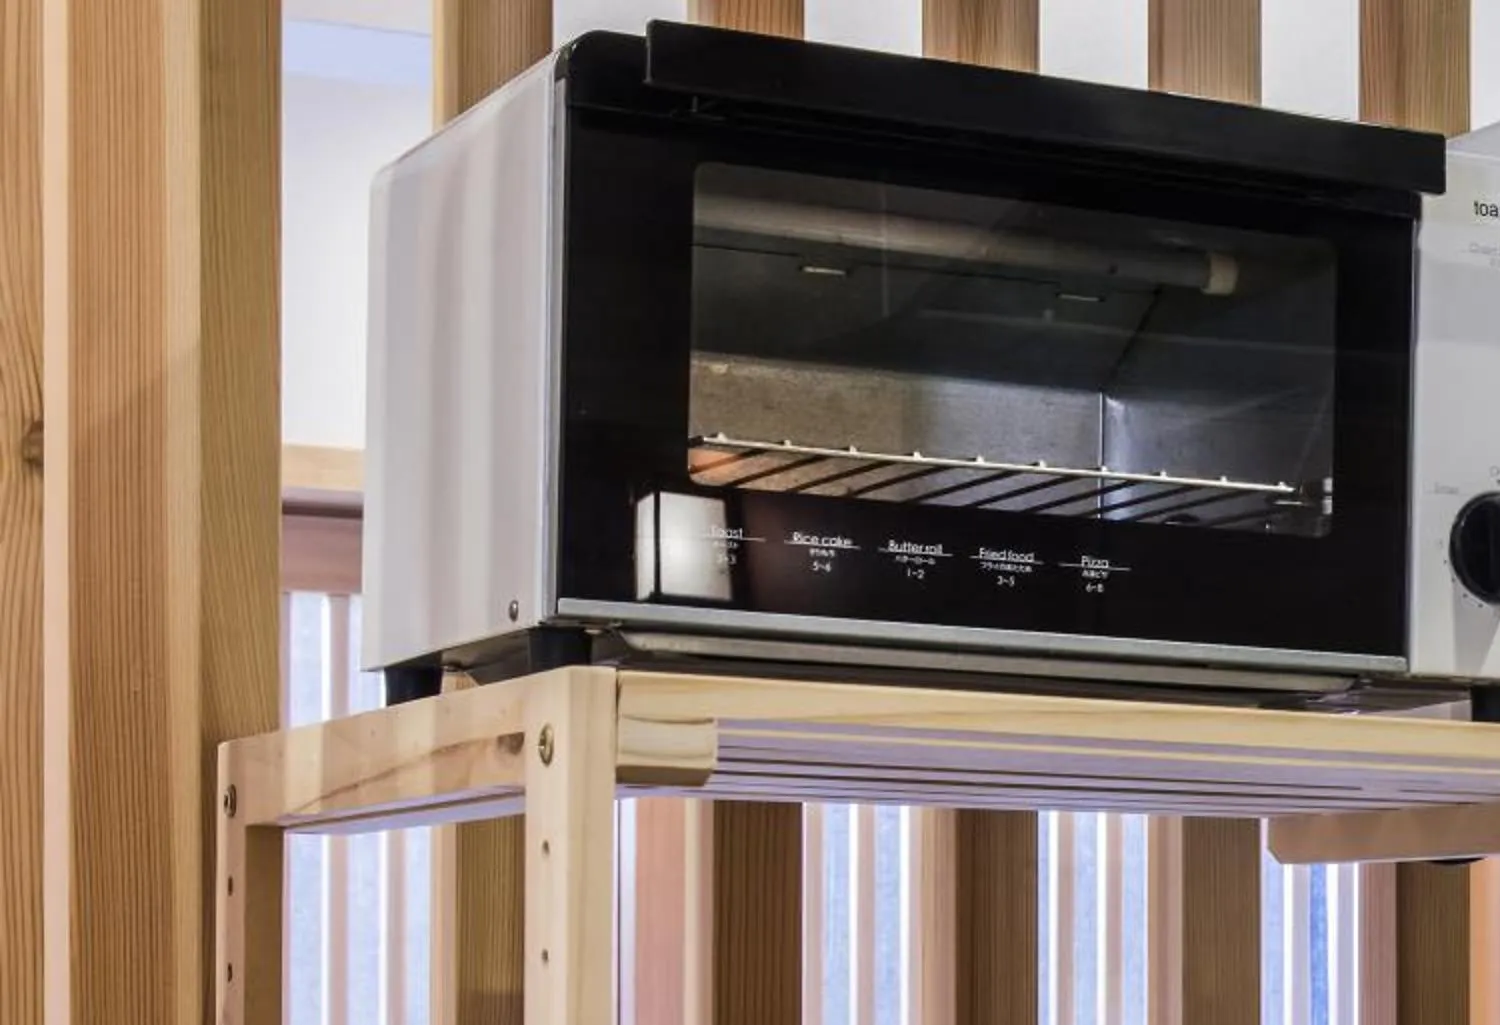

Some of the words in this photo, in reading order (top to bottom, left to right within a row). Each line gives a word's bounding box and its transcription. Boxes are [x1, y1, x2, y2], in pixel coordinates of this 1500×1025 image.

[793, 531, 820, 544] Rice
[822, 536, 854, 547] cake
[979, 547, 1007, 560] Fried
[1009, 550, 1035, 562] food
[1081, 555, 1109, 568] Pizza
